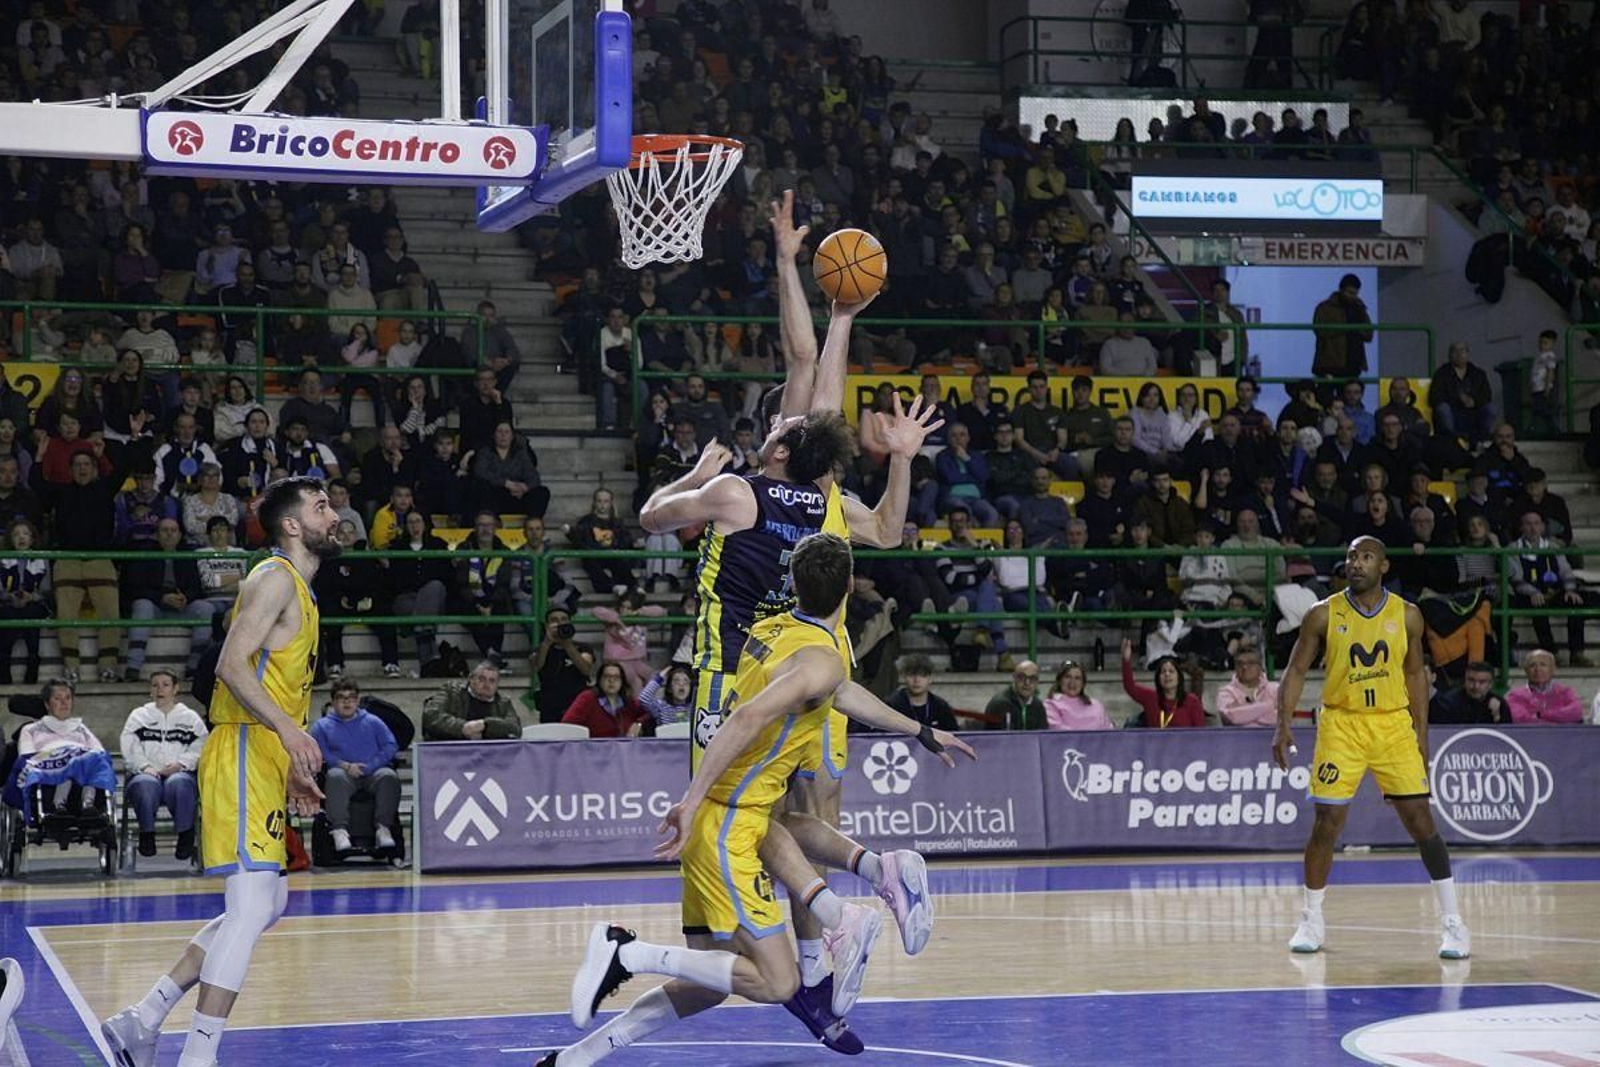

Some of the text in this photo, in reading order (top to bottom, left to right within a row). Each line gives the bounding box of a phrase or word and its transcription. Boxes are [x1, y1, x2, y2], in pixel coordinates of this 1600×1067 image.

[230, 124, 460, 164] BricoCentro
[1264, 242, 1409, 261] EMERXENCIA
[1365, 689, 1376, 707] 11
[1087, 760, 1311, 794] BricoCentro
[1443, 751, 1523, 770] ARROCERÍA
[1440, 766, 1526, 804] GIJÓN
[525, 791, 673, 823] XURISG
[840, 798, 1015, 836] enteDixital
[1128, 793, 1298, 828] Paradelo
